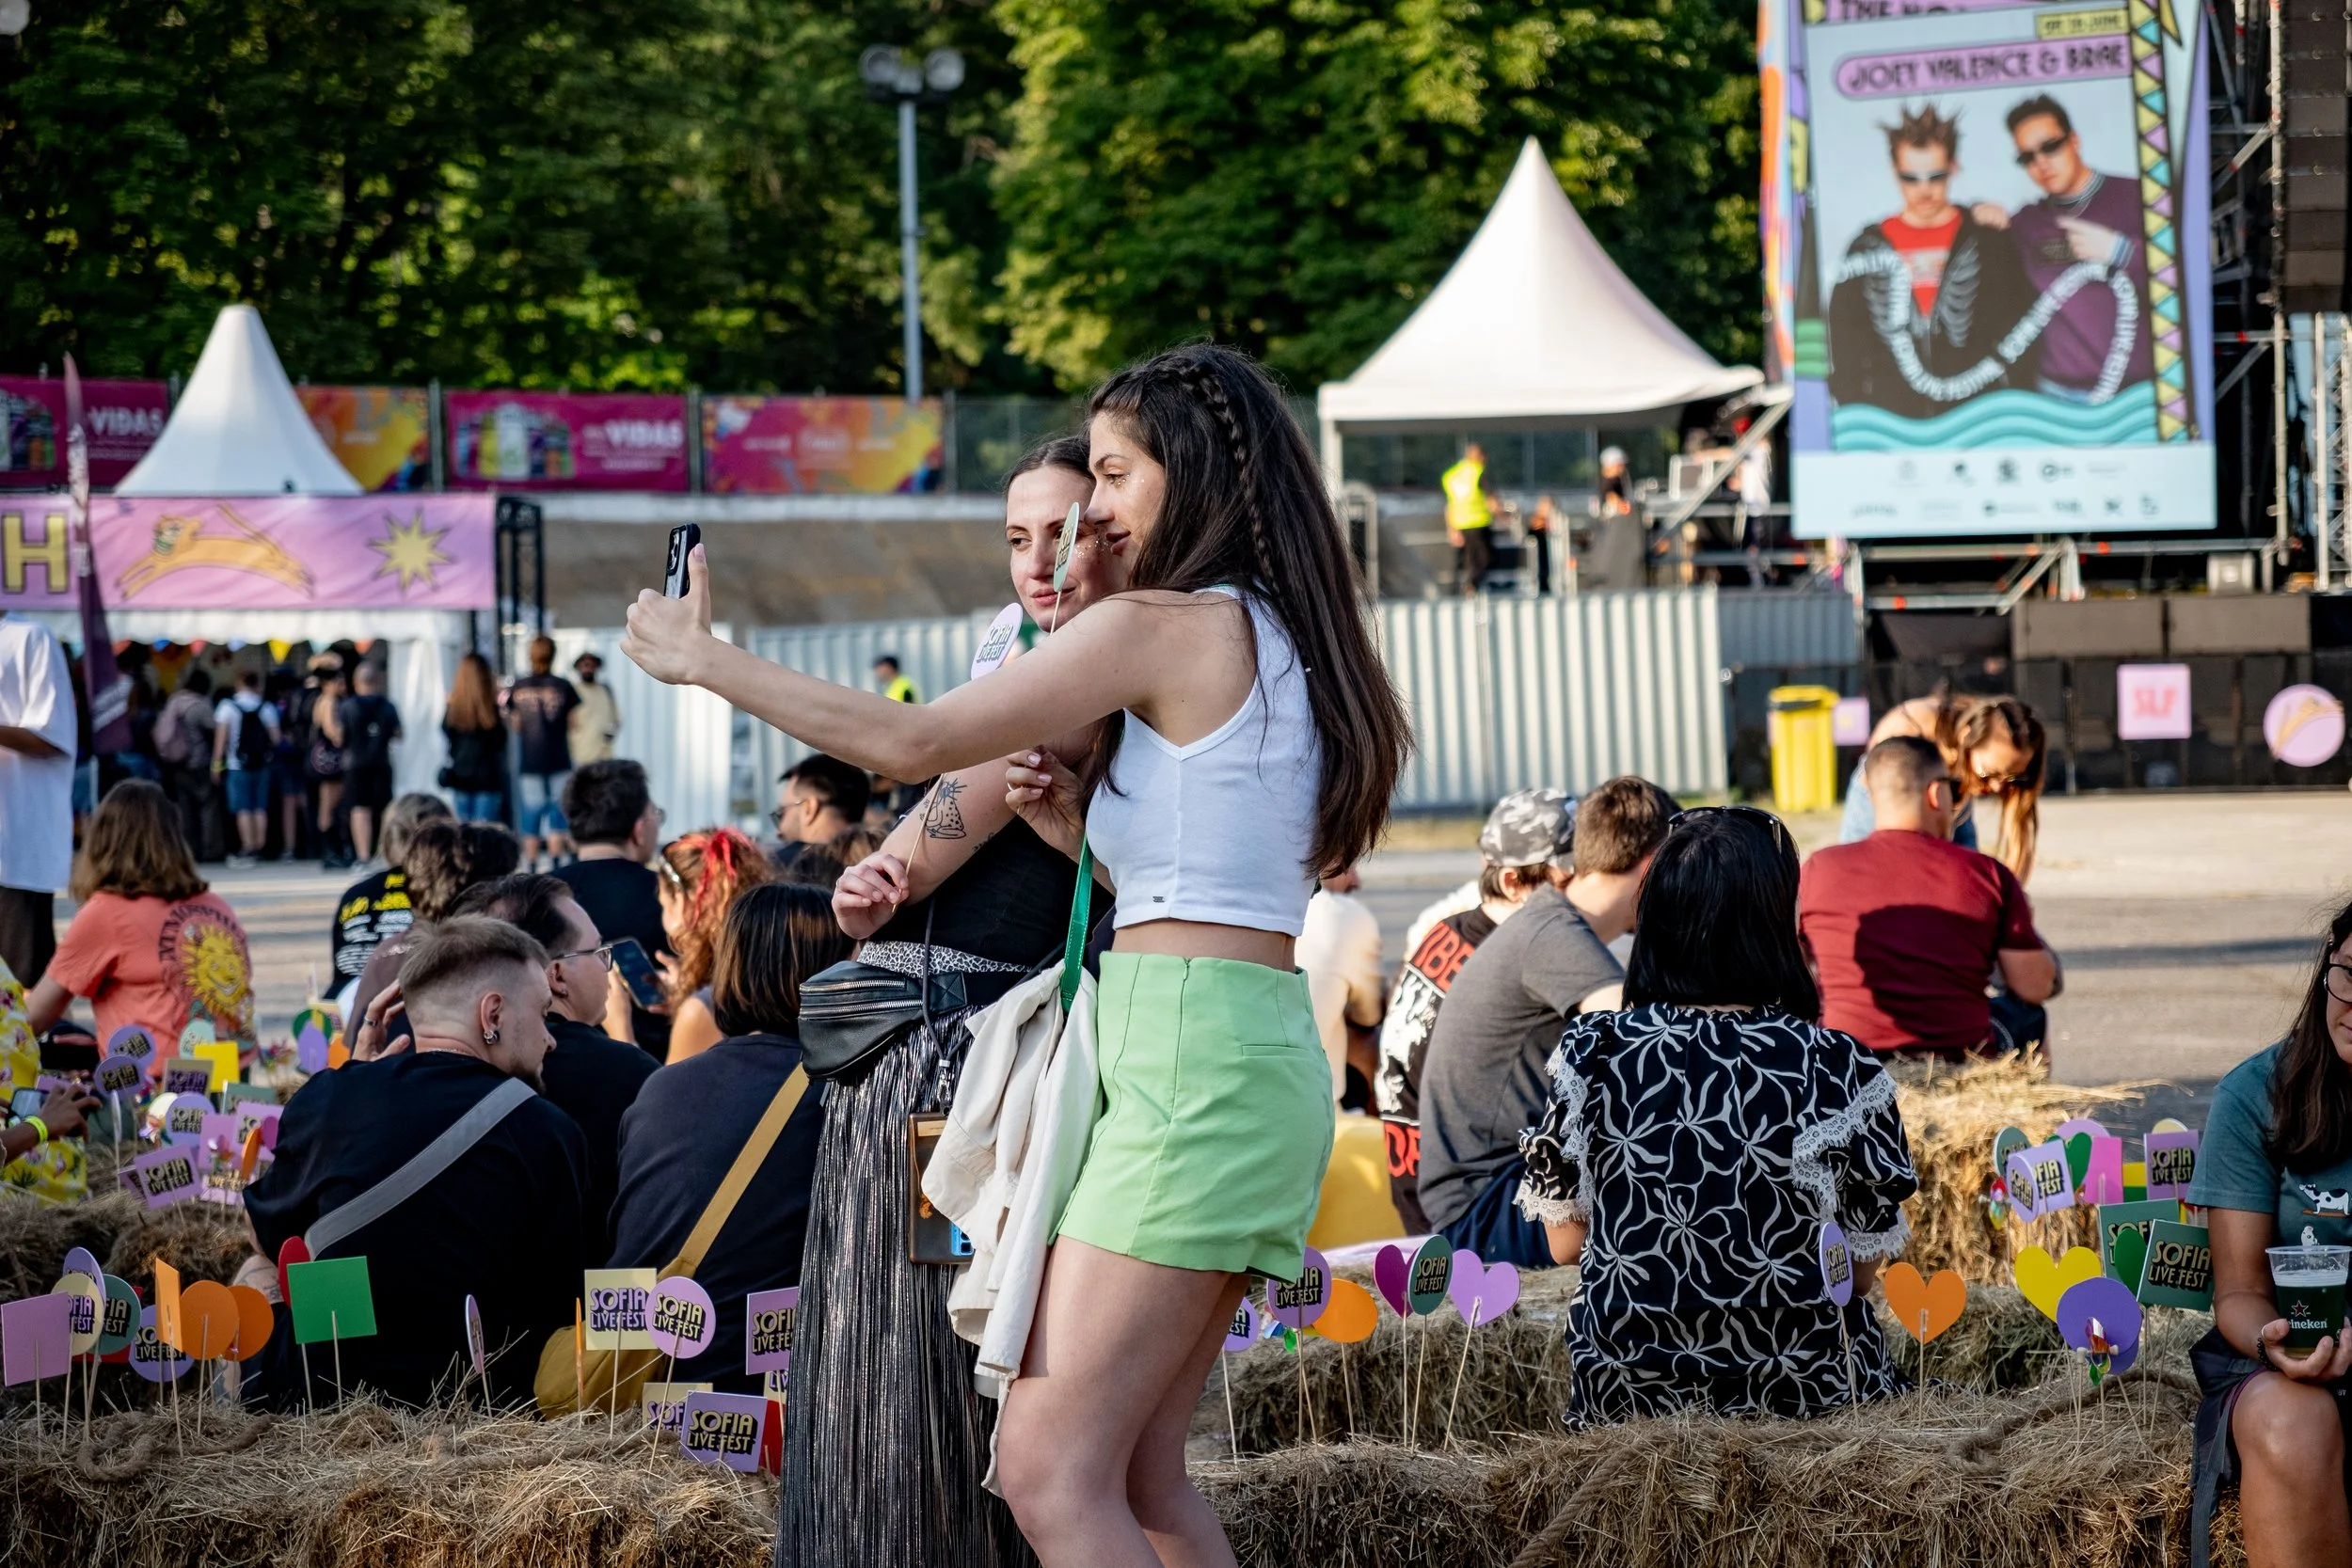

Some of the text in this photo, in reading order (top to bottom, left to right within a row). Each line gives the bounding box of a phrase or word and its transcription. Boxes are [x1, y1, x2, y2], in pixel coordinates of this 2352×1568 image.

[1850, 61, 1919, 91] JOEY
[2039, 48, 2059, 74] &
[984, 624, 1013, 646] SOFIA
[2150, 1148, 2192, 1169] SOFIA
[145, 1158, 190, 1182] SOFIA
[2151, 1167, 2170, 1183] LIVE
[1416, 1256, 1447, 1276] SOFIA
[1824, 1243, 1846, 1268] SOFIA
[2152, 1240, 2212, 1271] SOFIA
[1414, 1276, 1443, 1292] LIVE FEST
[2148, 1265, 2208, 1289] LIVE FEST
[590, 1287, 646, 1311] SOFIA
[655, 1293, 704, 1324] SOFIA
[1275, 1288, 1319, 1307] LIVE FEST
[590, 1310, 616, 1328] LIVE
[652, 1313, 702, 1338] LIVE FEST
[134, 1344, 159, 1360] LIVE
[752, 1335, 775, 1353] LIVE
[646, 1401, 685, 1424] SOF
[689, 1410, 753, 1435] SOFIA
[686, 1432, 751, 1451] LIVE FEST
